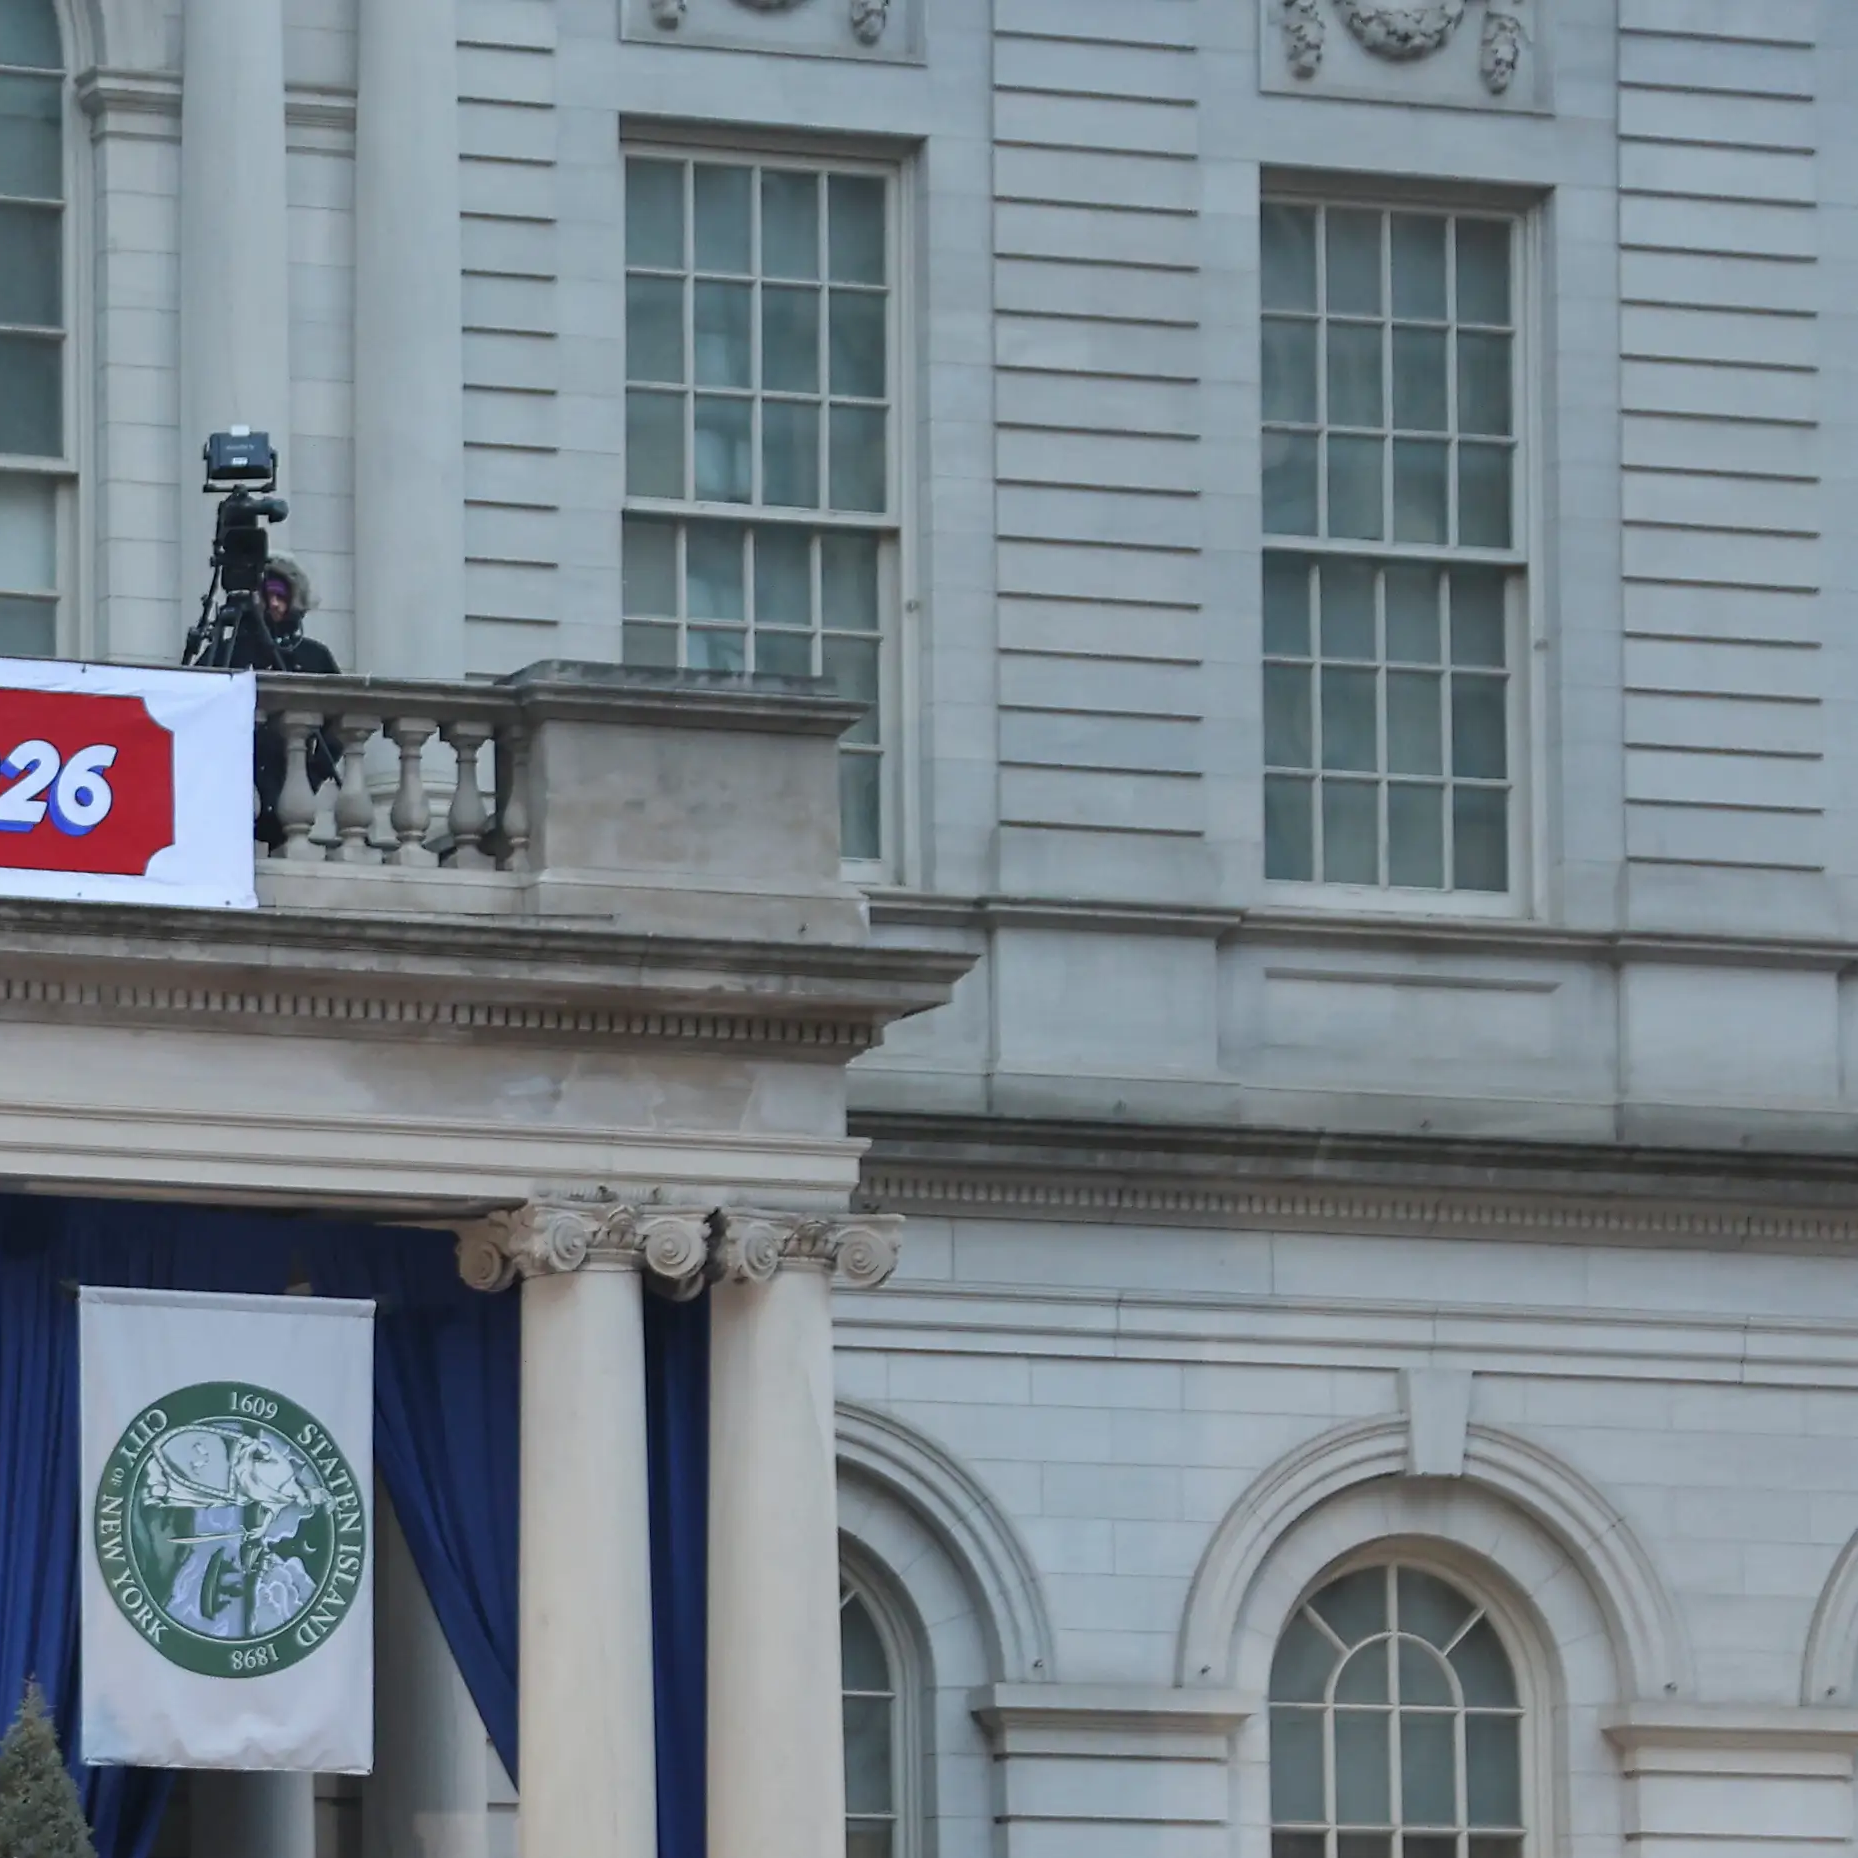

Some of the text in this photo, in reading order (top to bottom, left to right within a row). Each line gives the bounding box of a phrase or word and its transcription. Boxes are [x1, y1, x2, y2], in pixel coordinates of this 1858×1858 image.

[120, 1408, 170, 1467] CITY
[230, 1391, 279, 1420] 1609
[100, 1494, 127, 1563] NEW
[295, 1423, 363, 1648] STATEN ISLAND
[111, 1566, 170, 1645] YORK
[230, 1642, 281, 1671] 1898
